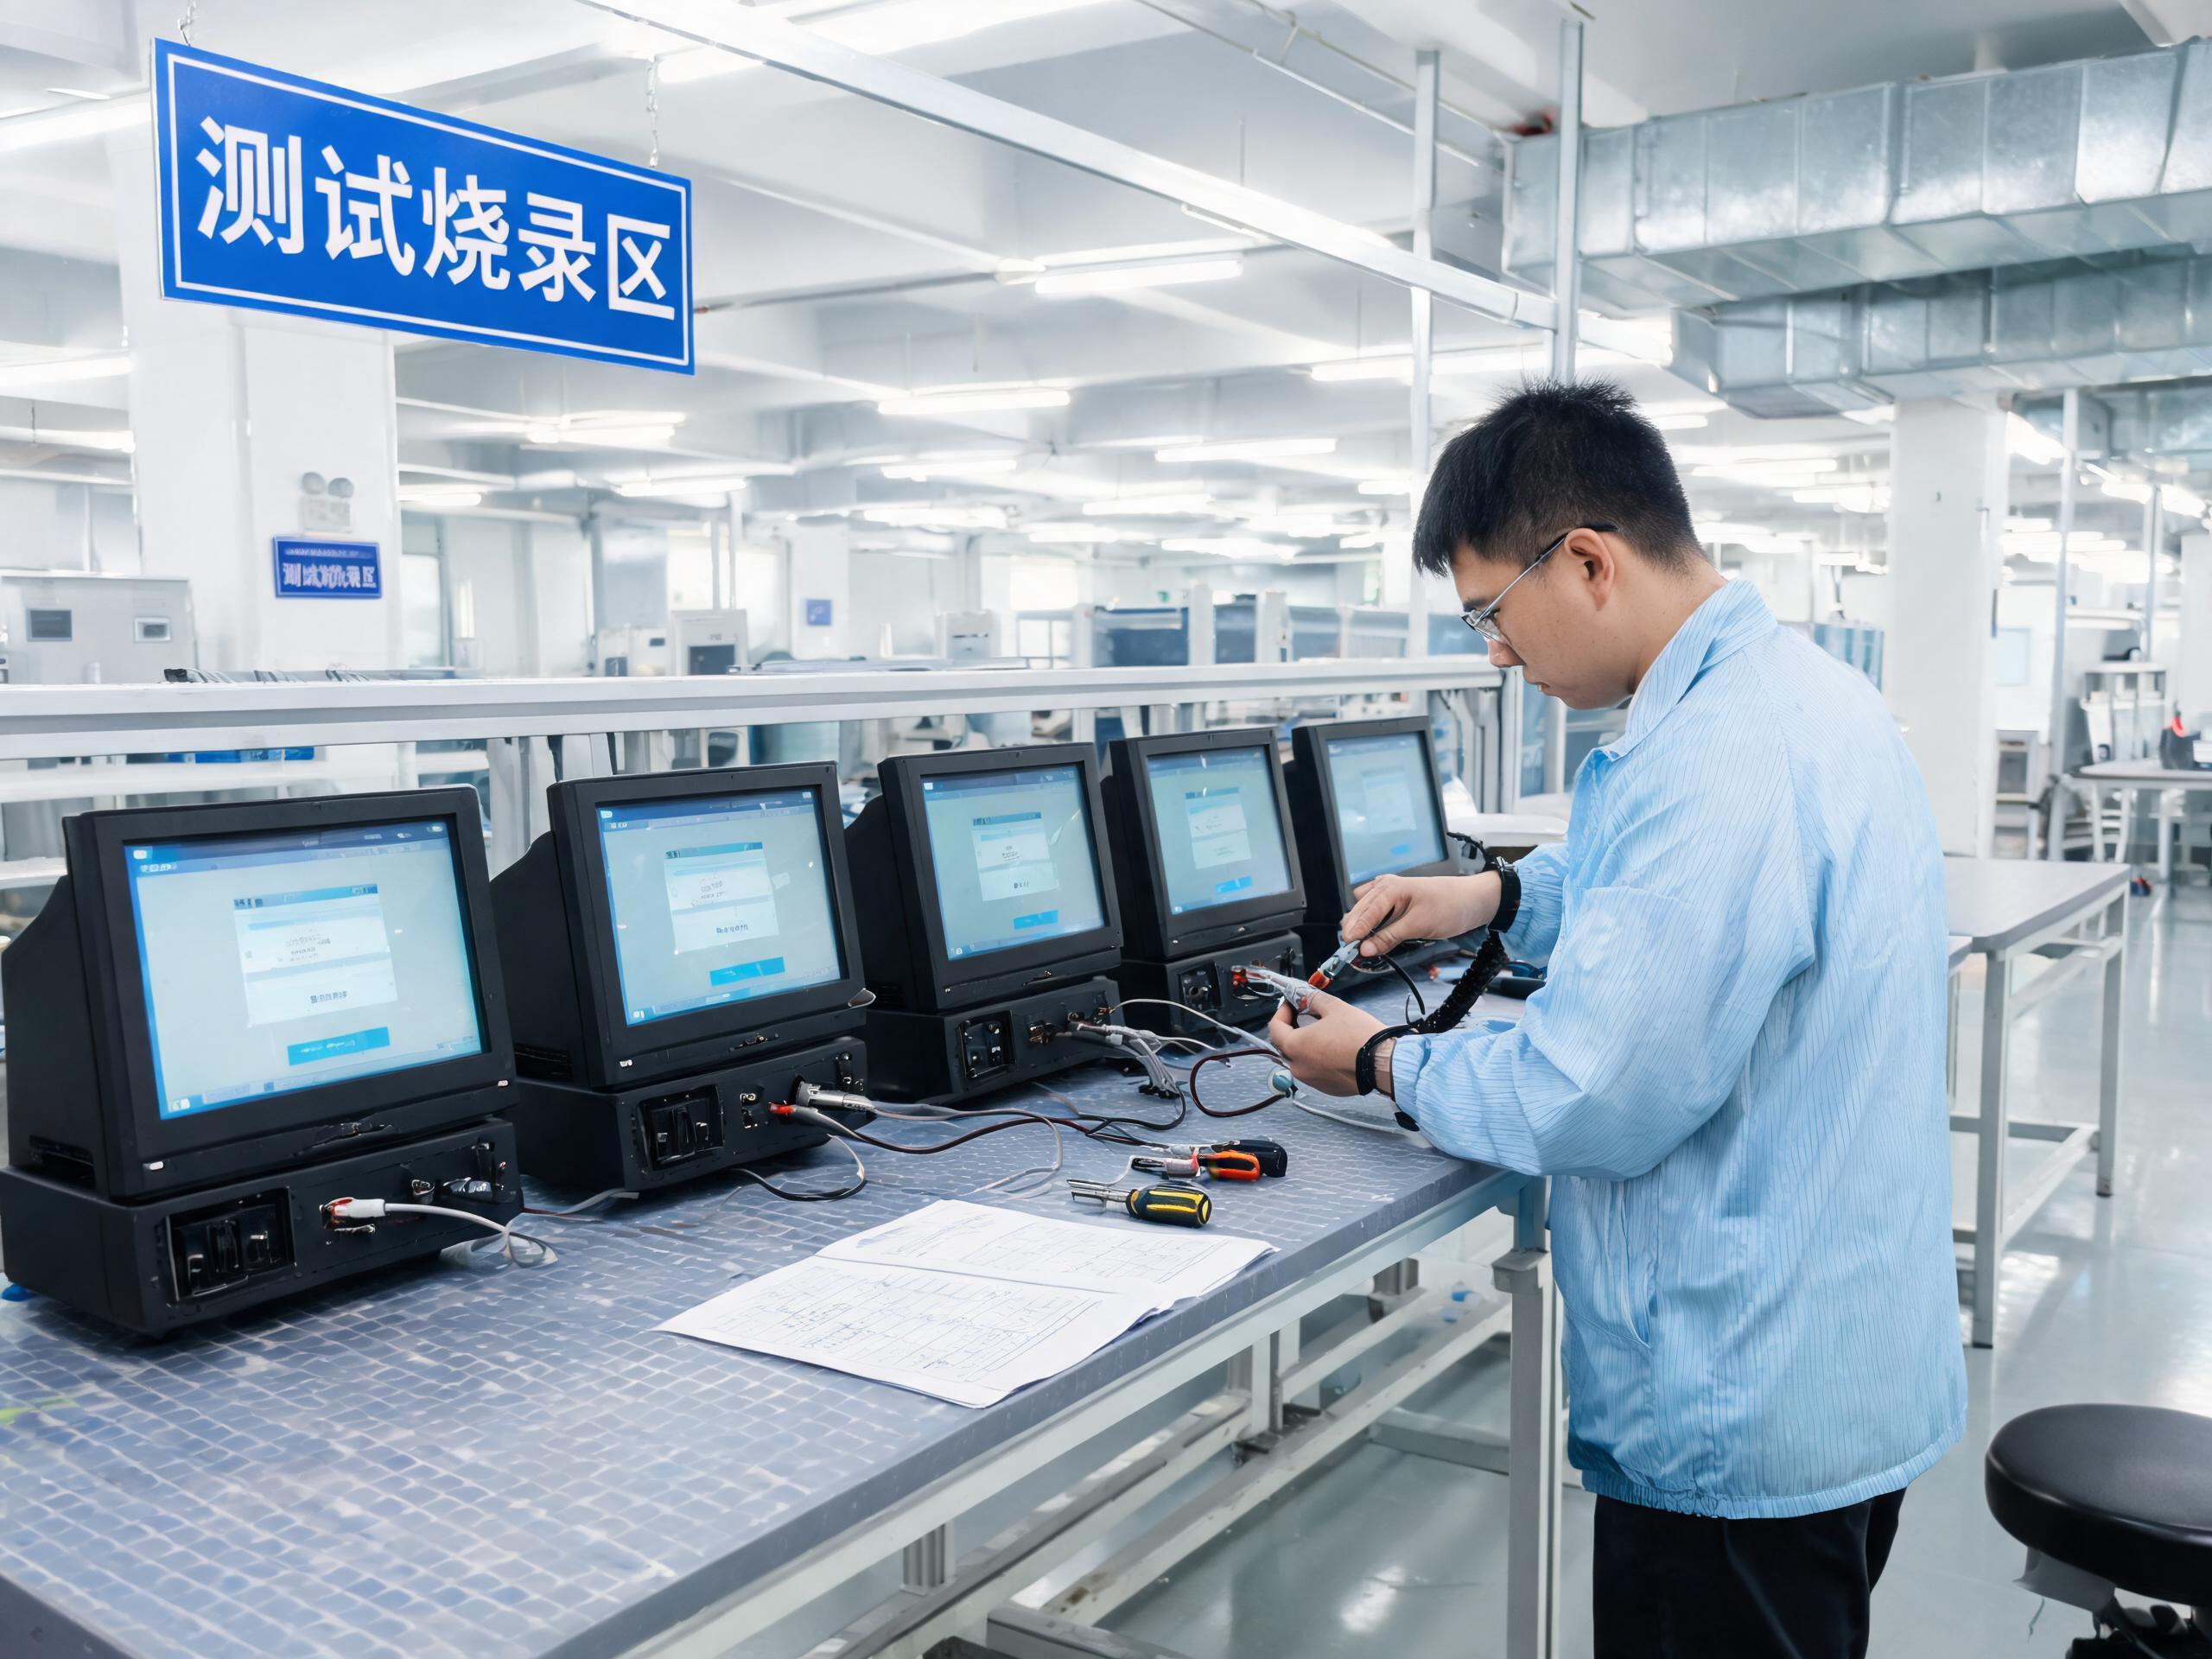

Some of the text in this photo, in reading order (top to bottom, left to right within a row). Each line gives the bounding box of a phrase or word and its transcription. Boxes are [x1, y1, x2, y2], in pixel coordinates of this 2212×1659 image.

[196, 116, 676, 321] 测试烧录区
